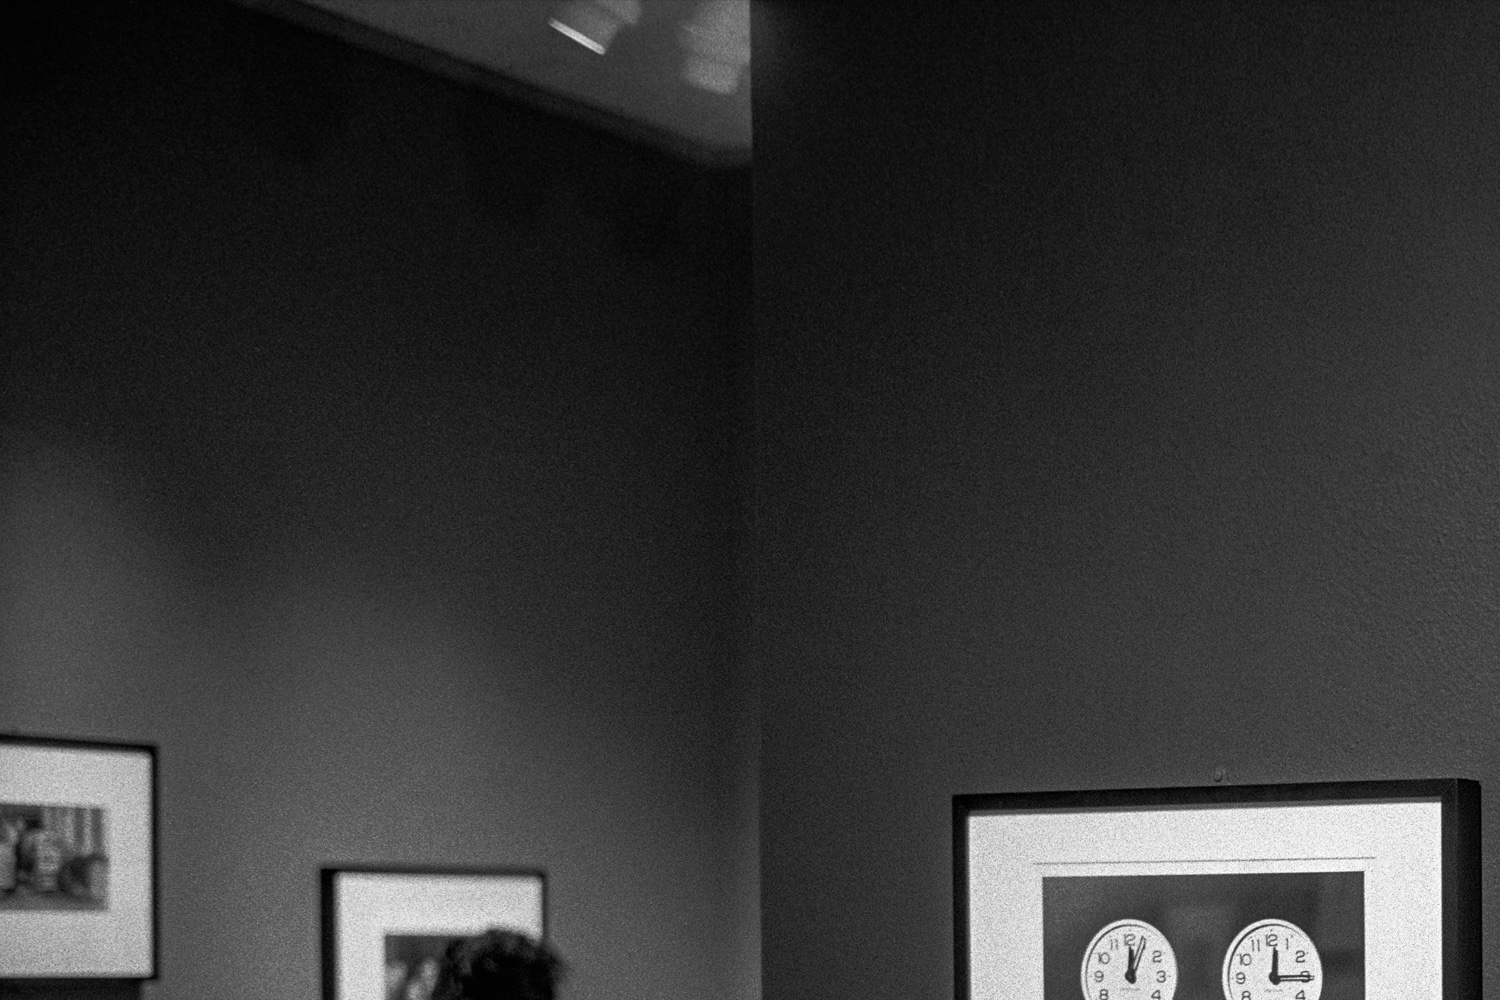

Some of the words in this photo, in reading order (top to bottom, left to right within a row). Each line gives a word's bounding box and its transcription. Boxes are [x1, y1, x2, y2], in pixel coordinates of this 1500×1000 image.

[1109, 939, 1119, 950] 11
[1124, 934, 1136, 946] 12
[1251, 939, 1260, 952] 11
[1265, 934, 1278, 947] 12
[1286, 938, 1289, 950] 1
[1098, 952, 1110, 965] 10
[1152, 950, 1162, 963] 2
[1239, 953, 1252, 966] 10
[1296, 950, 1305, 963] 2
[1094, 970, 1104, 983] 9
[1156, 970, 1166, 983] 3
[1236, 972, 1245, 984] 9
[1099, 989, 1108, 1000] 8
[1151, 990, 1161, 1000] 4
[1295, 990, 1305, 1000] 4
